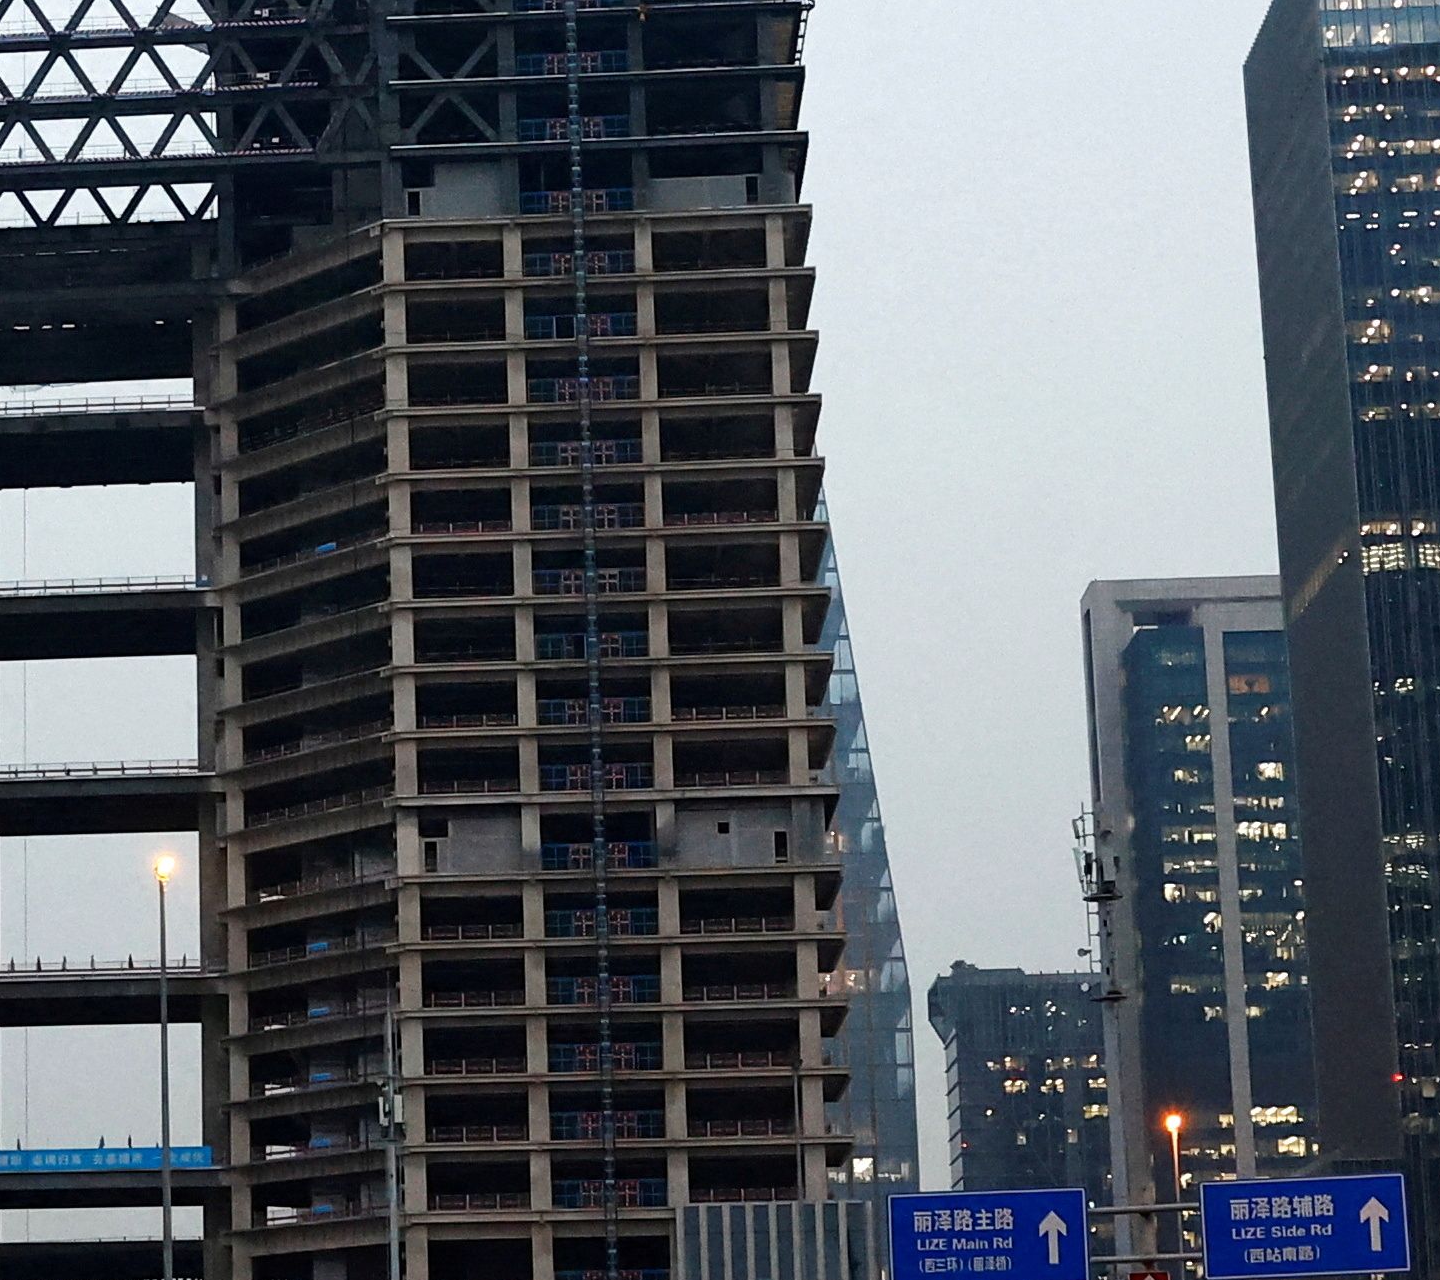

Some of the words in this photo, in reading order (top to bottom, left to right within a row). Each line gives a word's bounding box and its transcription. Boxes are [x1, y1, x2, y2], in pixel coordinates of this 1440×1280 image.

[1229, 1194, 1334, 1221] 丽泽路辅路
[913, 1207, 1014, 1233] 丽泽路主路
[1232, 1227, 1265, 1240] LIZE
[1271, 1225, 1306, 1238] Side
[1311, 1224, 1332, 1236] Rd
[917, 1238, 948, 1251] LIZE
[952, 1237, 988, 1250] Main
[993, 1237, 1013, 1249] Rd
